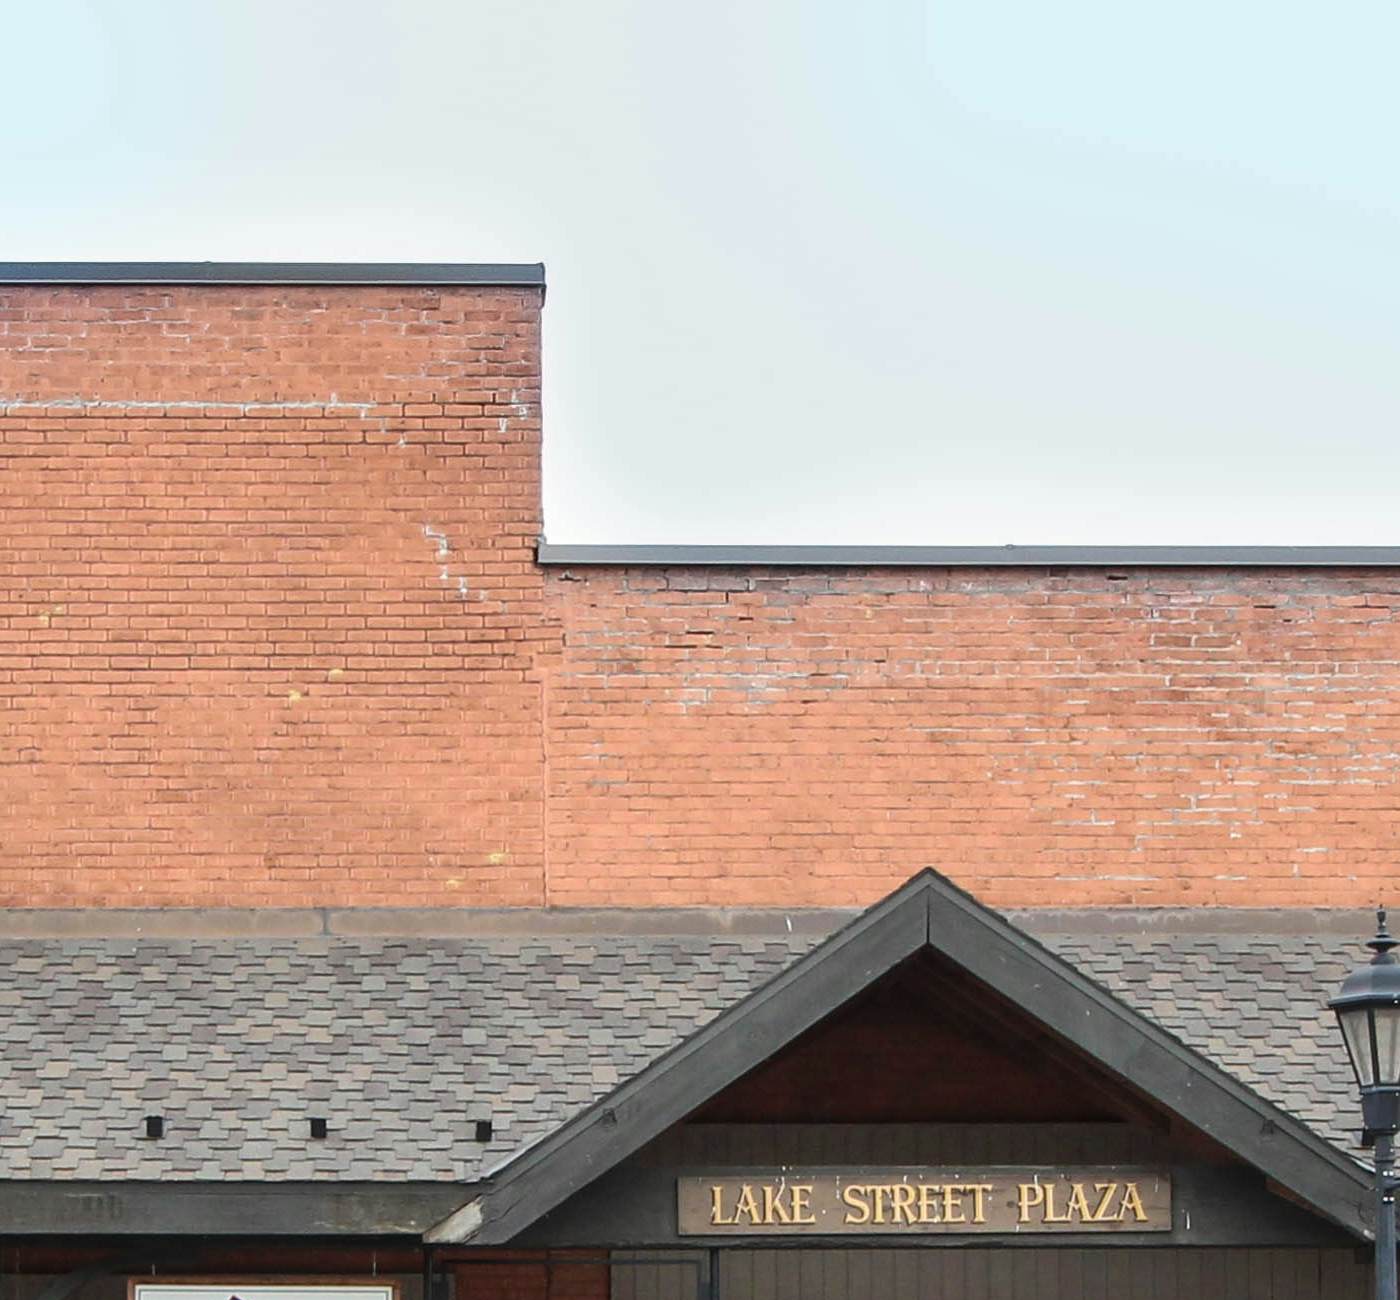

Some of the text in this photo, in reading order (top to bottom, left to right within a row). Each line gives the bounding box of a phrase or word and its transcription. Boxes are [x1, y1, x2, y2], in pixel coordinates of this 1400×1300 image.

[711, 1182, 1149, 1225] LAKE STREET PLAZA
